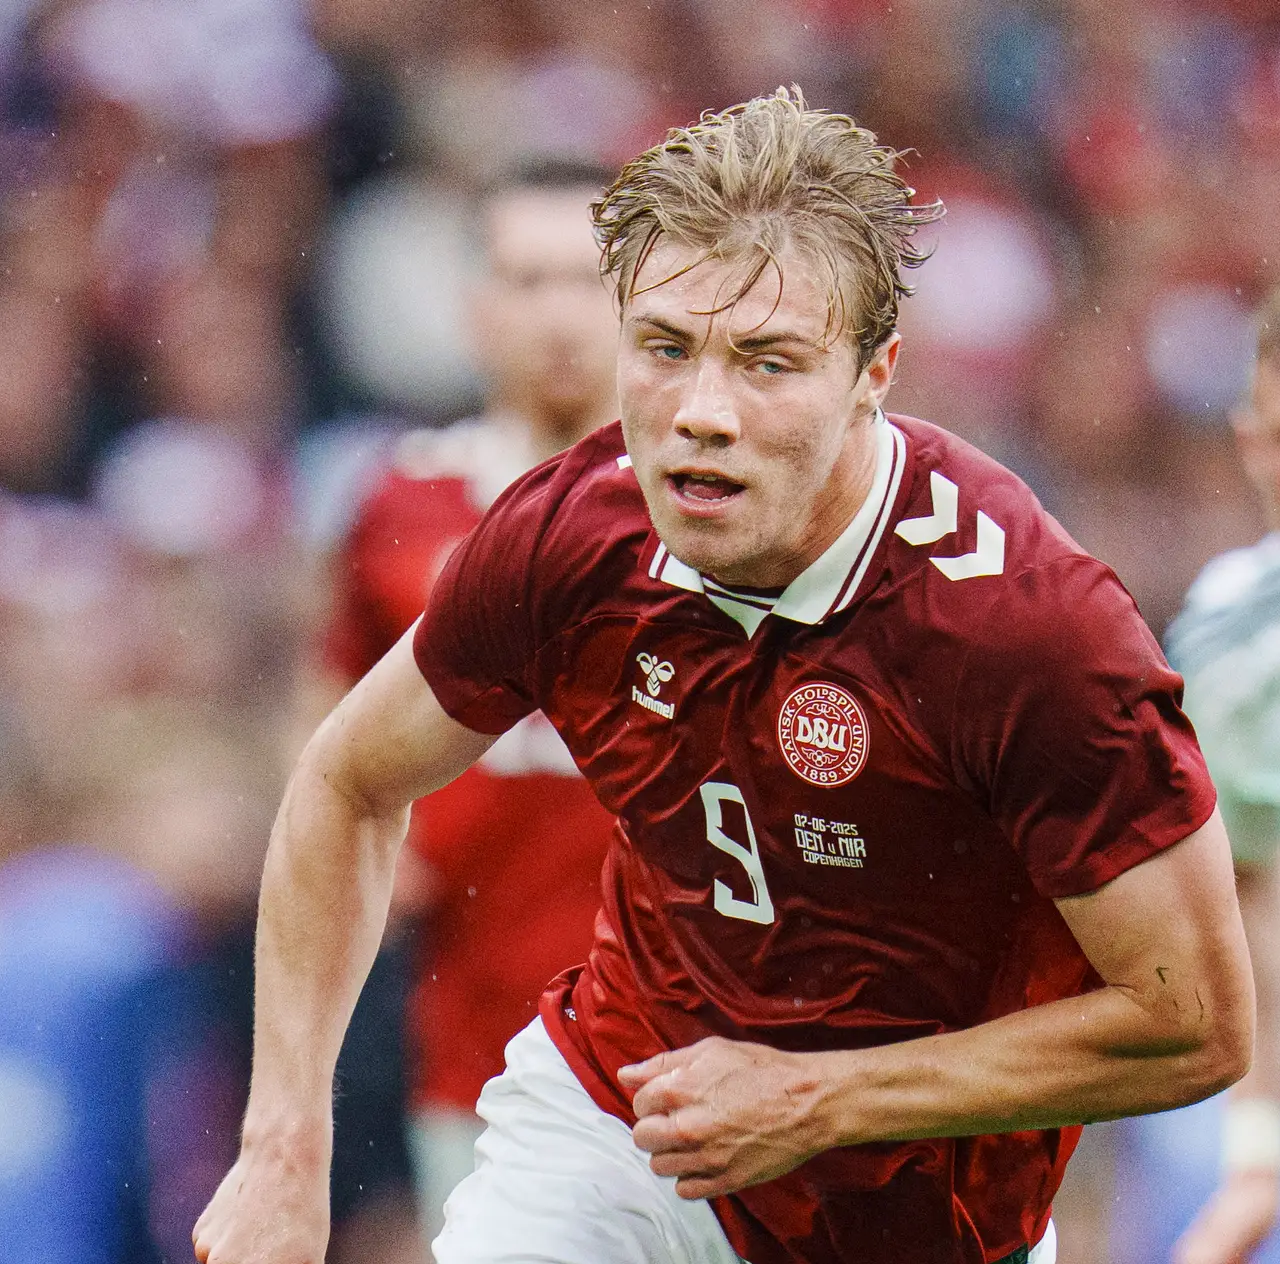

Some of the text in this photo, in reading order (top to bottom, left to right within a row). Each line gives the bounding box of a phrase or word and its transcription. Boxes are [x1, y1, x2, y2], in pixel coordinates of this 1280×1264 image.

[632, 685, 675, 719] hummel
[782, 706, 800, 764] DANSK
[795, 715, 848, 752] DBU
[802, 765, 838, 782] 1889
[794, 814, 859, 836] 07-06-2025
[699, 781, 775, 925] 9
[794, 828, 825, 853] DEN
[838, 836, 867, 858] NIR
[803, 850, 864, 868] COPENHAGEN
